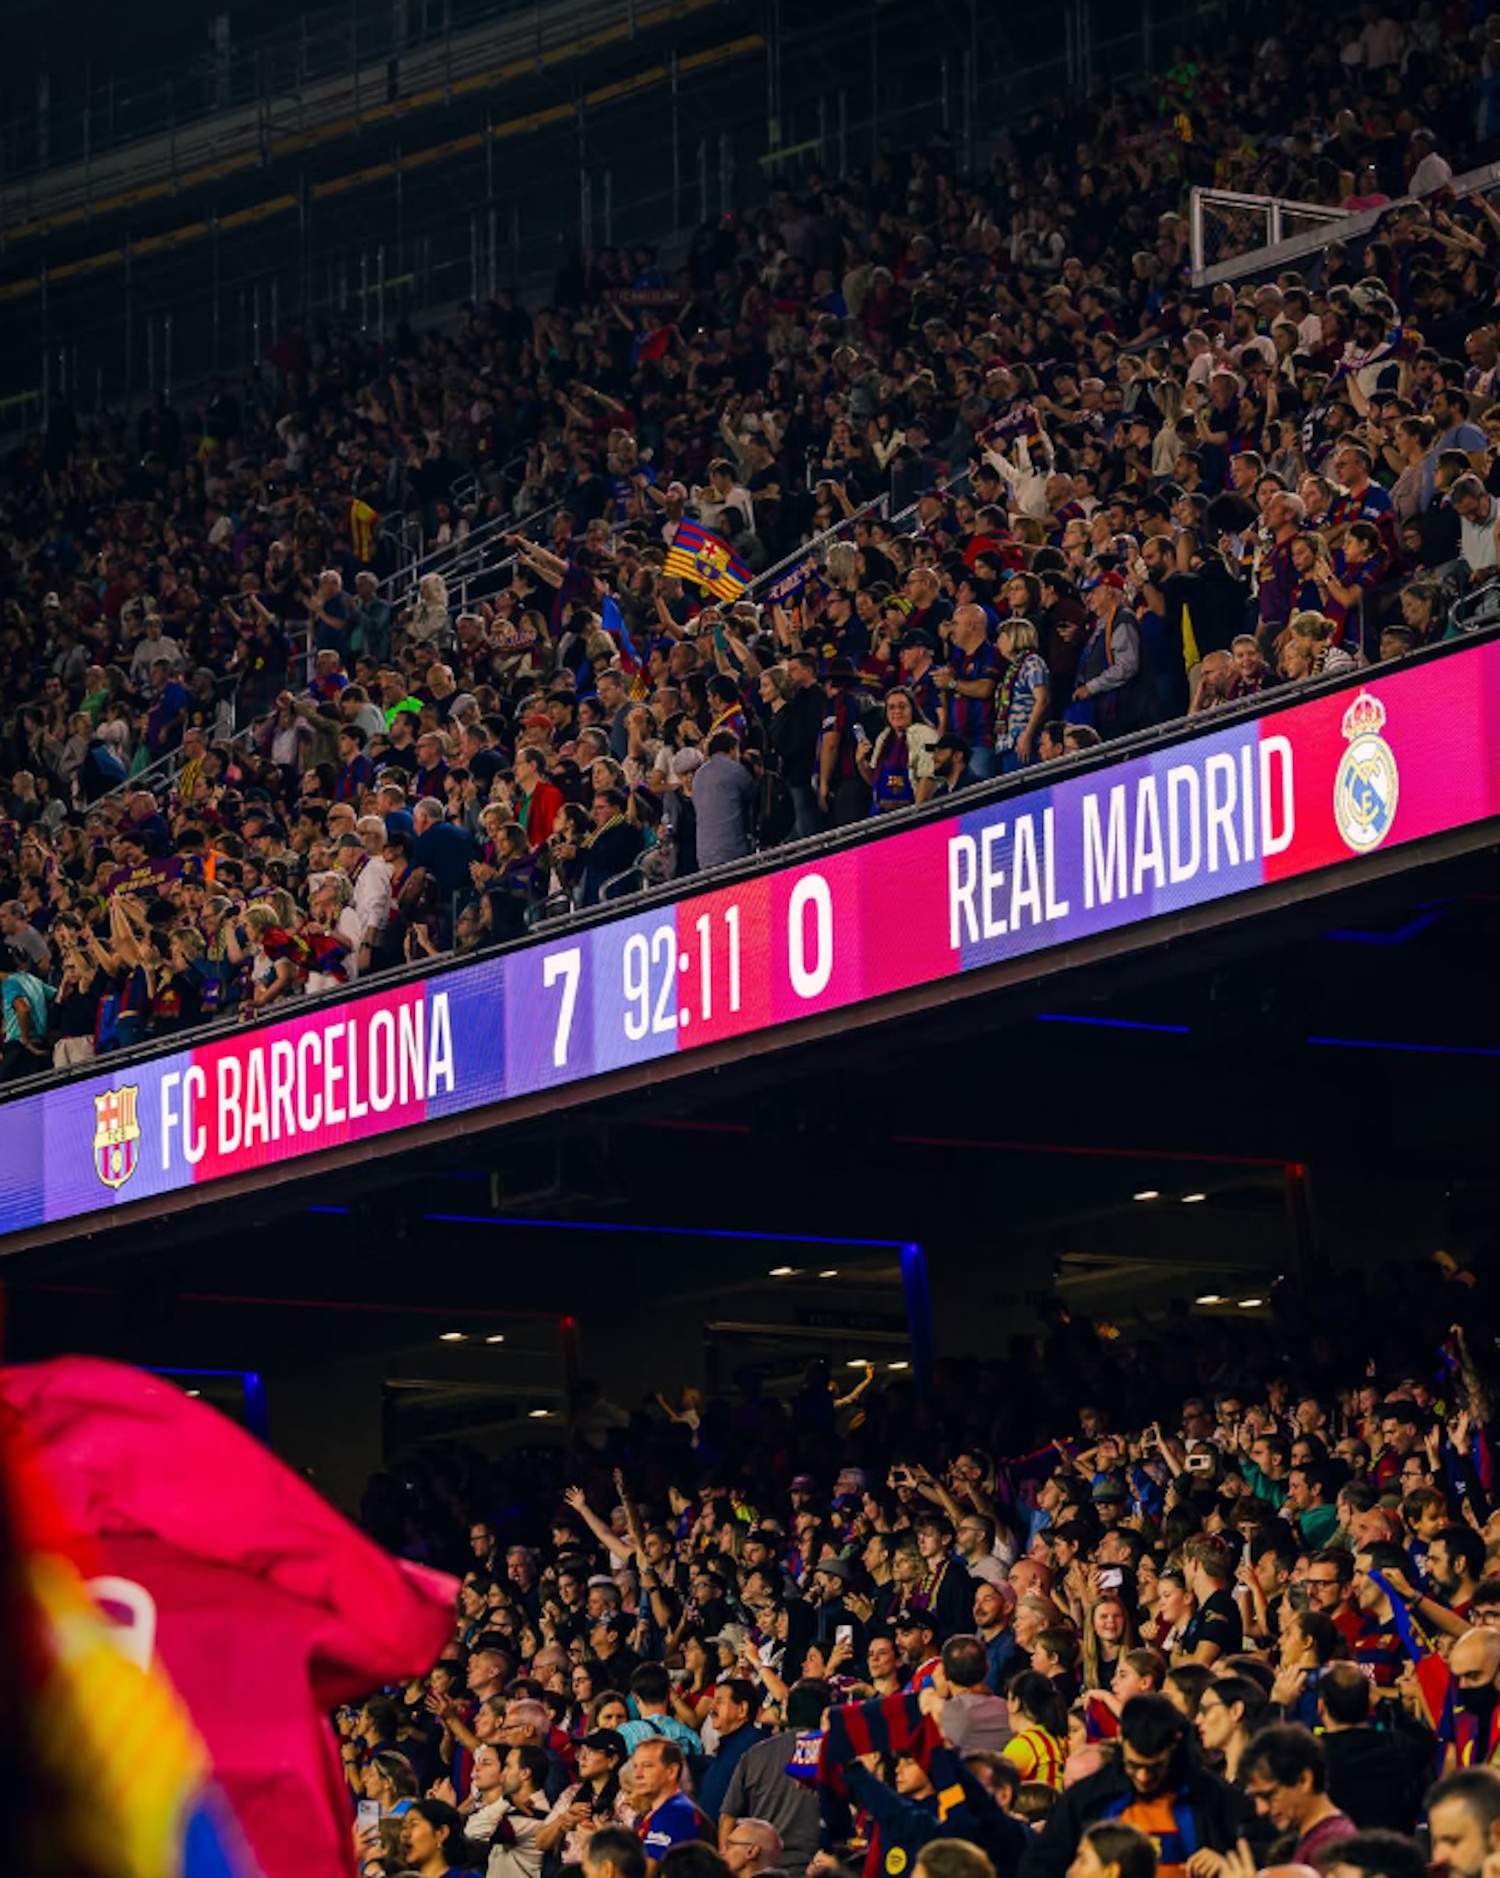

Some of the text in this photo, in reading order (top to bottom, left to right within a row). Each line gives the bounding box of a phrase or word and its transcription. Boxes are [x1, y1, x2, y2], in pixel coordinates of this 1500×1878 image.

[949, 736, 1295, 949] REAL MADRID
[622, 905, 742, 1041] 92:11
[788, 874, 834, 999] 0
[543, 947, 582, 1068] 7
[160, 991, 456, 1172] FC BARCELONA
